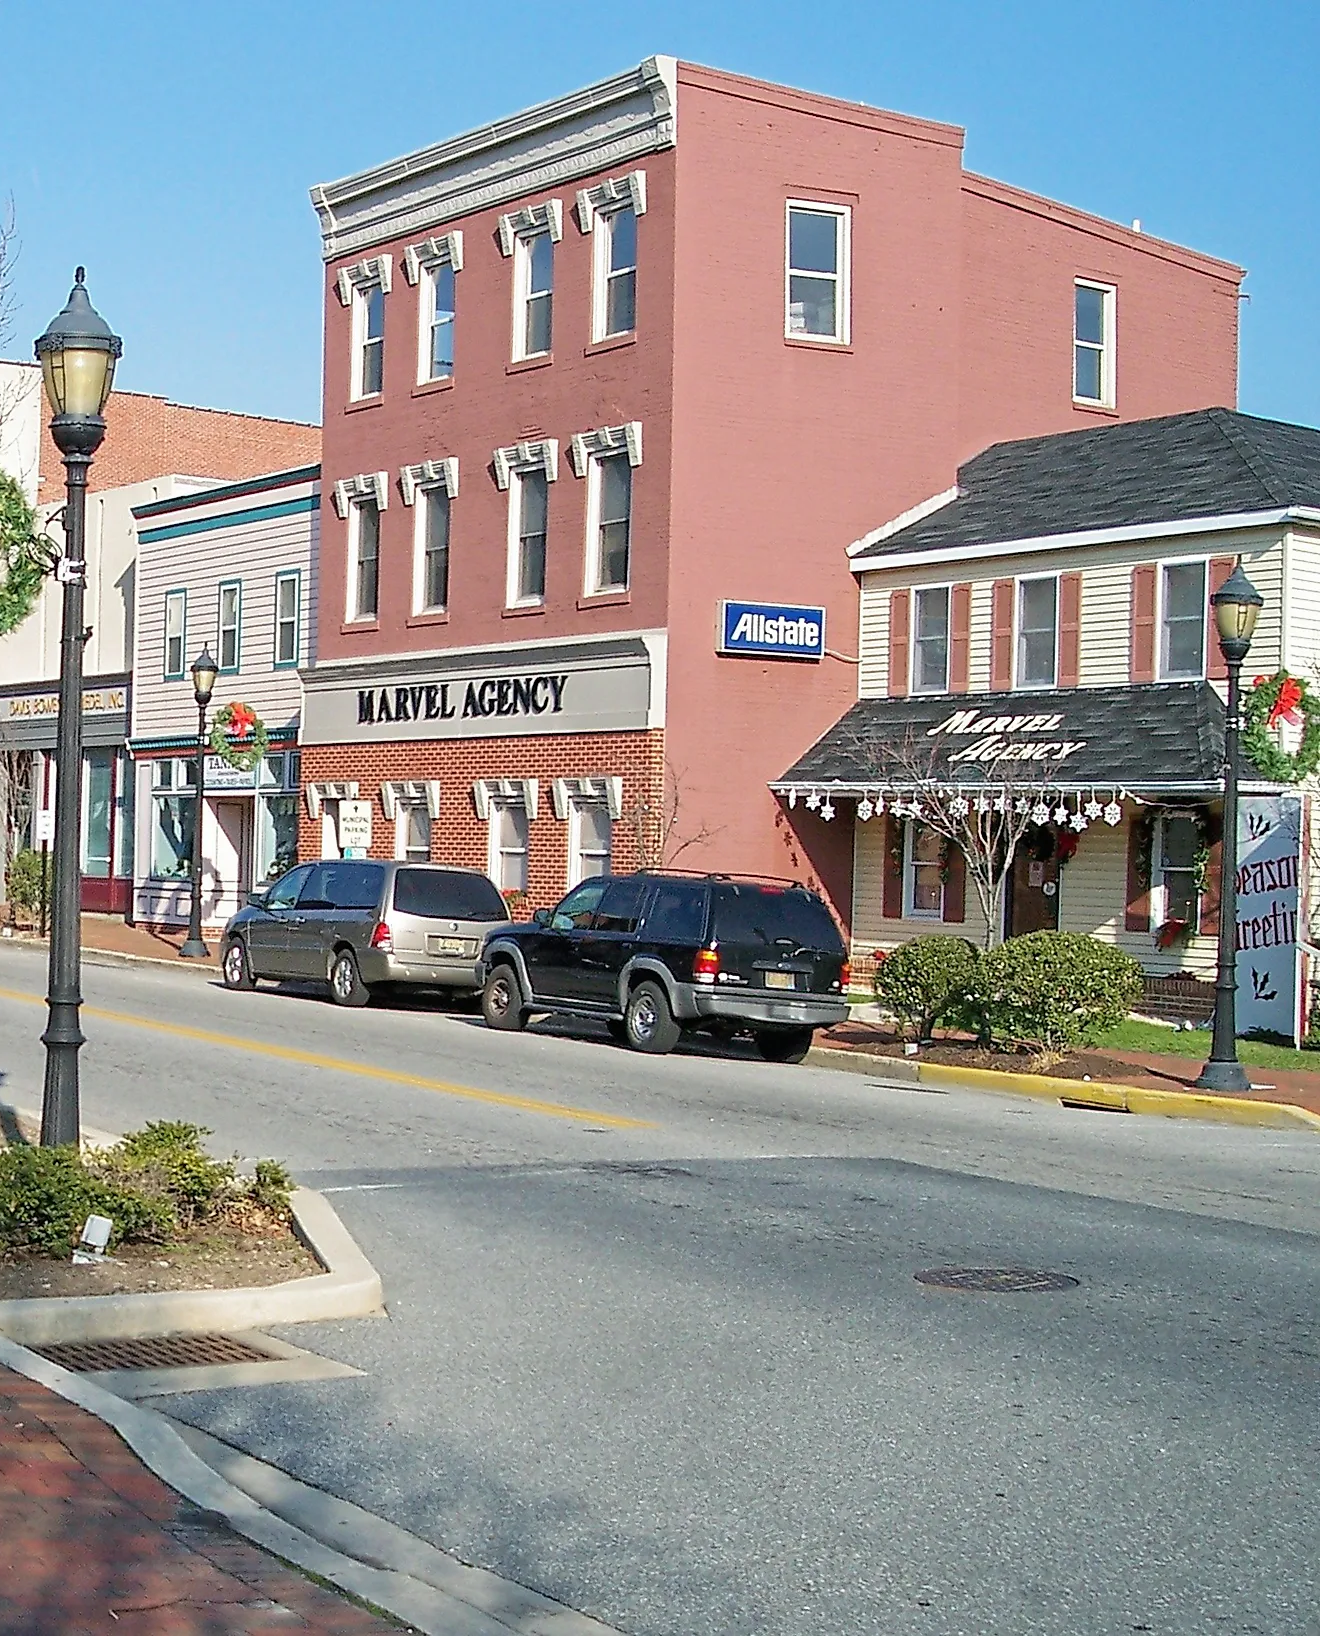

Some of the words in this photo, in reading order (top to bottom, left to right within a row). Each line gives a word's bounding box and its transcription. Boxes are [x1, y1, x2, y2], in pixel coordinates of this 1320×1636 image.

[731, 613, 820, 647] Allstate
[34, 697, 59, 714] BOWE
[357, 683, 456, 725] MARVEL
[461, 675, 569, 720] AGENCY
[926, 709, 1065, 736] MARVEL
[947, 734, 1087, 762] AGENCY
